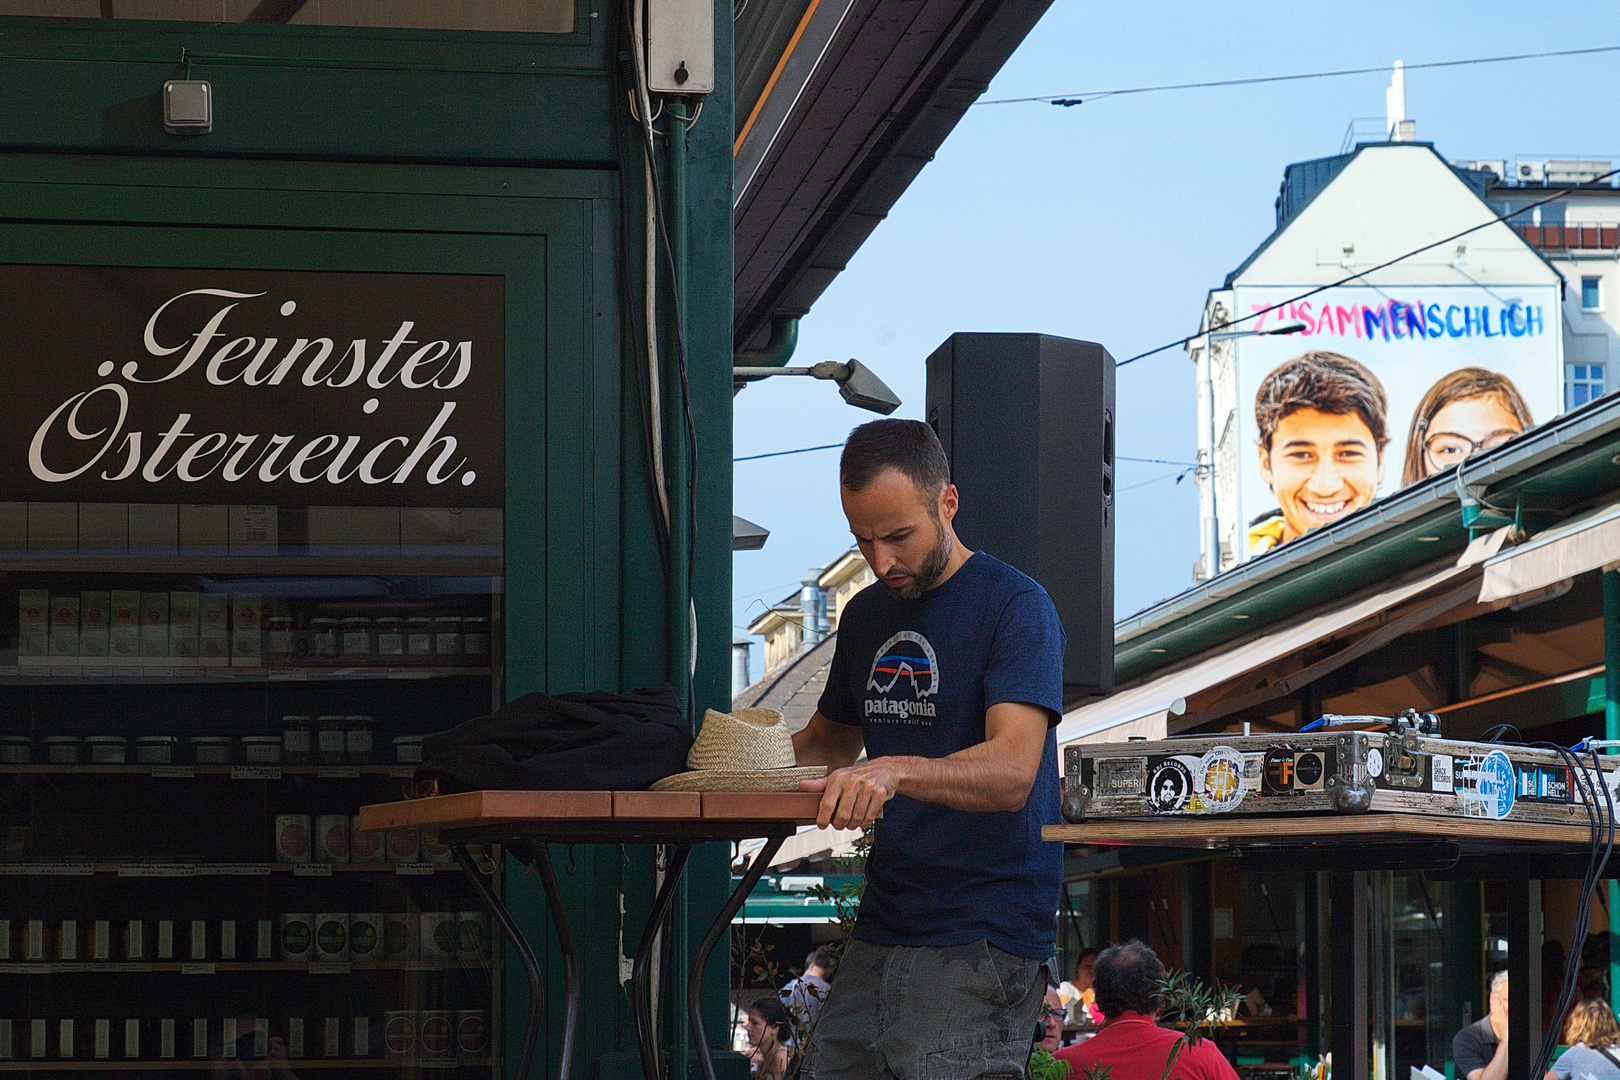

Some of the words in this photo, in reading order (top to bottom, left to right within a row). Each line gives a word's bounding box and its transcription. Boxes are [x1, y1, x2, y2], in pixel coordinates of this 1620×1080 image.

[122, 288, 473, 389] Feinstes
[28, 361, 477, 486] Österreich.
[864, 697, 937, 719] patagonia
[1433, 775, 1452, 784] RECORDS
